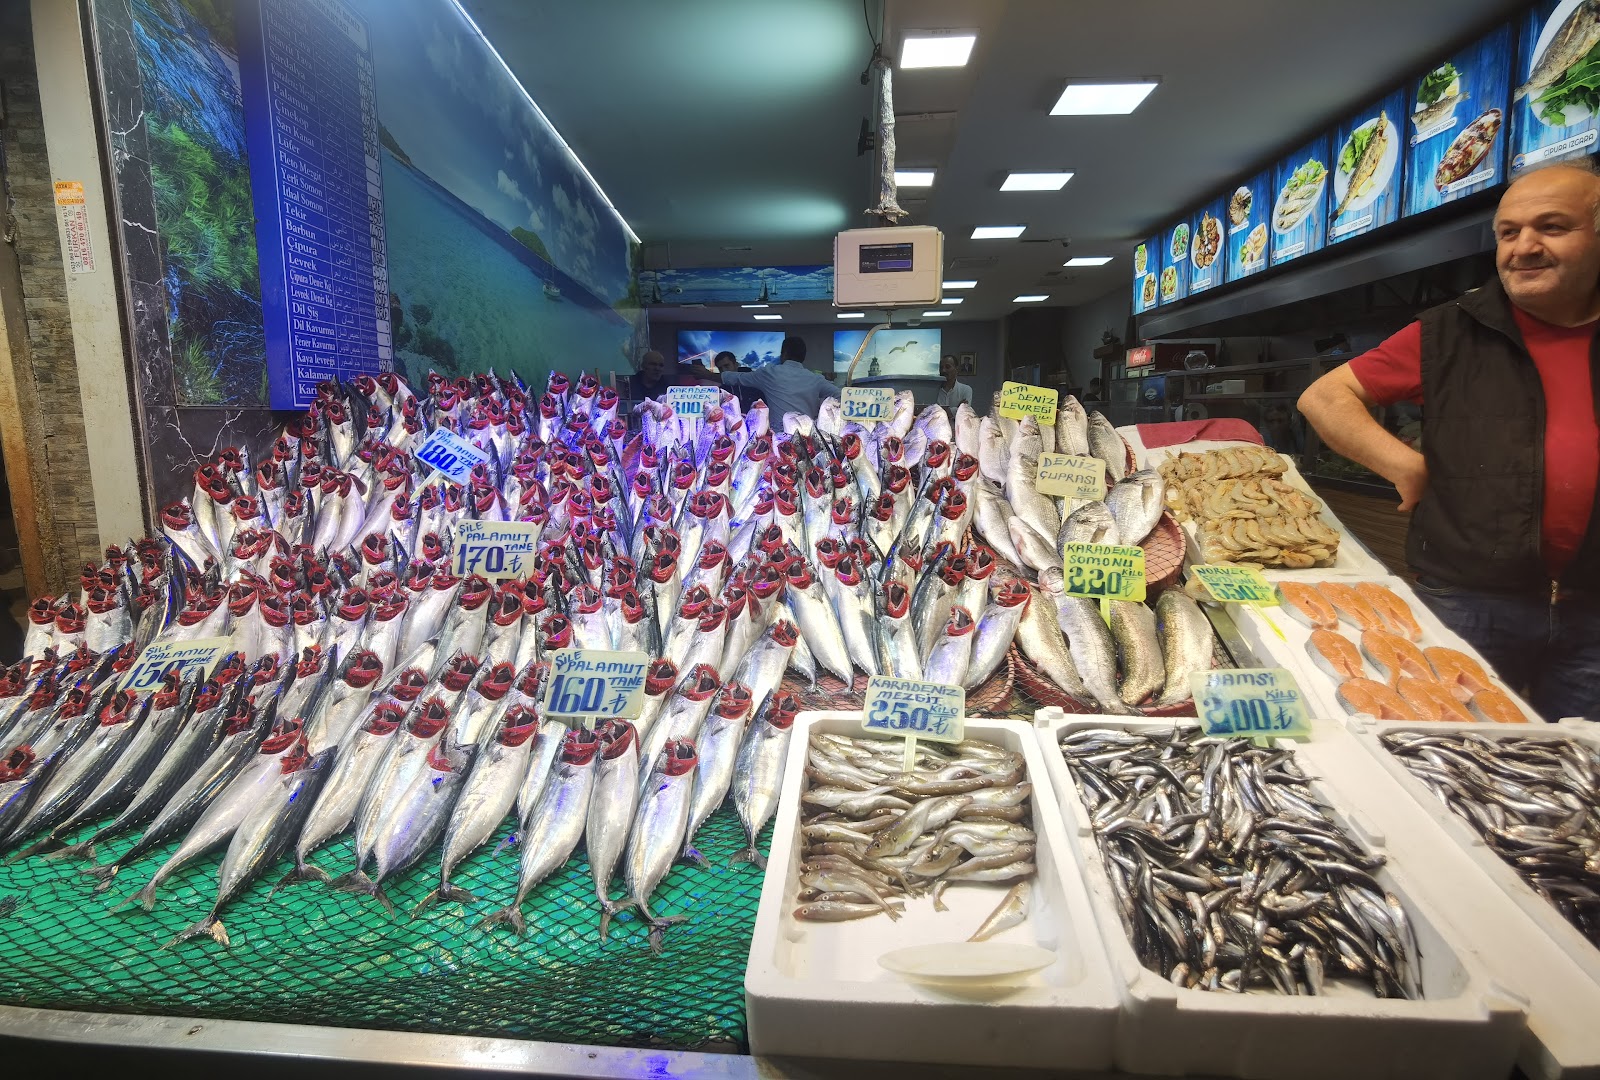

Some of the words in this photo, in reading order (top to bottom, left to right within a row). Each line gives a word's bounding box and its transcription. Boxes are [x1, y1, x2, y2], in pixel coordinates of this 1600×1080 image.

[269, 45, 306, 80] Sardalya
[273, 80, 309, 114] Palamut
[275, 98, 309, 131] Çinekop
[278, 132, 300, 155] Lüfer
[293, 124, 314, 148] Kanat
[280, 166, 299, 183] Yerli
[300, 177, 324, 198] Somon
[300, 190, 324, 213] Somon
[284, 201, 307, 220] Tekir
[286, 218, 316, 240] Barbun
[70, 220, 80, 258] FURKAN
[287, 236, 318, 256] Çipura
[288, 252, 318, 272] Levrek
[290, 268, 308, 285] Çipura
[291, 285, 310, 298] Levrek
[292, 302, 306, 316] Dil
[307, 306, 319, 320] Şiş
[294, 318, 304, 330] Dil
[306, 320, 335, 336] Kavurma
[295, 334, 312, 348] Fener
[312, 338, 336, 351] Kavurma
[296, 351, 314, 365] Kaya
[314, 352, 336, 367] levreği
[297, 367, 332, 380] Kalamar
[298, 384, 318, 395] Kari
[846, 388, 882, 396] ÇUPRA
[1003, 386, 1028, 396] OLTA
[1018, 394, 1055, 405] DENİZ
[1042, 457, 1097, 472] DENİZ
[1040, 470, 1096, 486] ÇUPRASI
[466, 532, 532, 542] PALAMUT
[504, 542, 534, 551] TANE
[1067, 544, 1143, 558] KARADENİZ
[1069, 554, 1133, 568] SOMONU
[147, 647, 220, 662] PALAMUT
[564, 660, 646, 675] PALAMUT
[608, 676, 644, 686] TANE
[870, 678, 960, 697] KARADENİZ
[876, 690, 944, 704] MEZGİT
[1266, 688, 1297, 699] KİLO
[928, 704, 958, 714] KİLO
